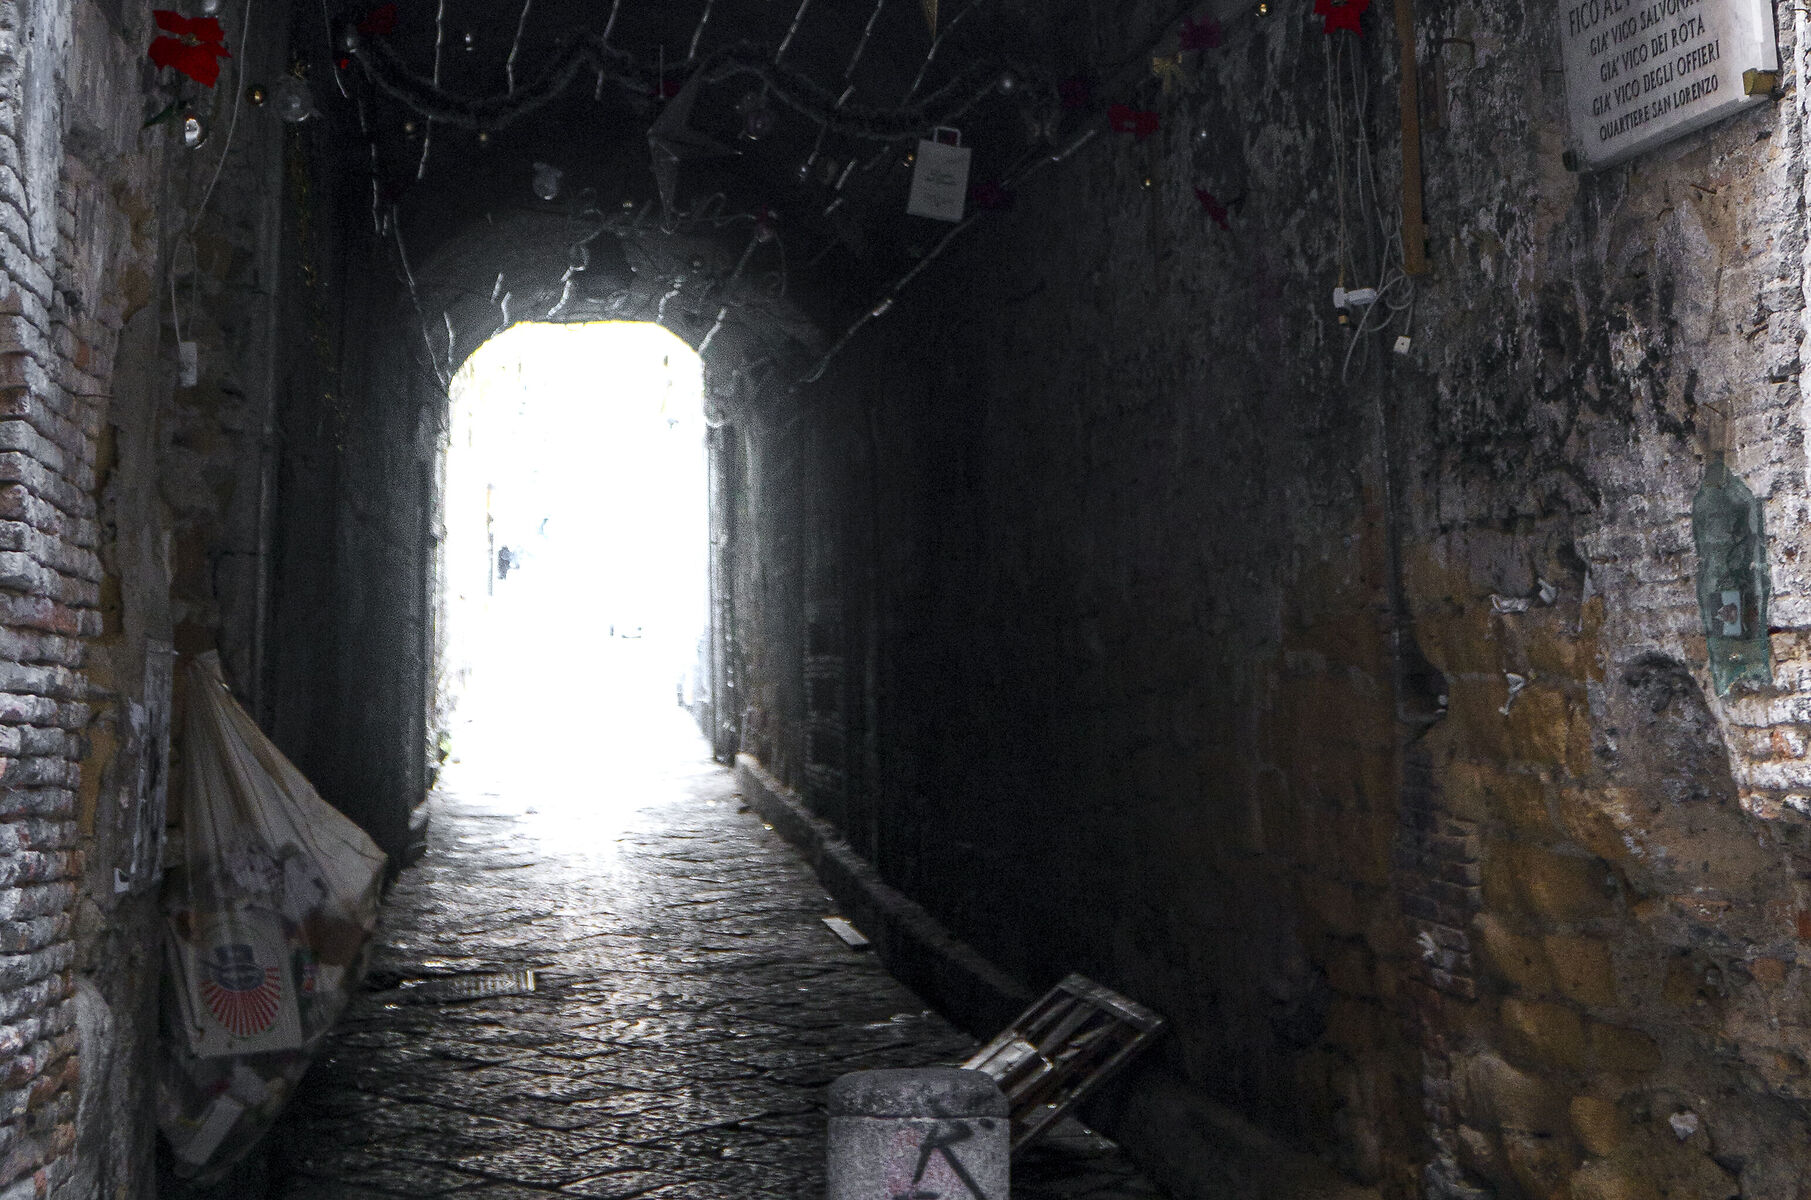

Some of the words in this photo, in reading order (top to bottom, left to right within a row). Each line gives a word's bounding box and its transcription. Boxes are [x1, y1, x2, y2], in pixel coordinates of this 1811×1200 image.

[1611, 16, 1637, 44] VICO
[1621, 44, 1647, 68] VICO
[1651, 33, 1667, 55] DEI
[1672, 15, 1705, 47] ROTA
[1615, 80, 1640, 105] VICO
[1643, 62, 1673, 92] DEGLI
[1677, 39, 1720, 77] OFFIERI
[1599, 106, 1649, 141] QUARTIERE
[1652, 97, 1671, 118] SAN
[1673, 74, 1718, 109] LORENZO
